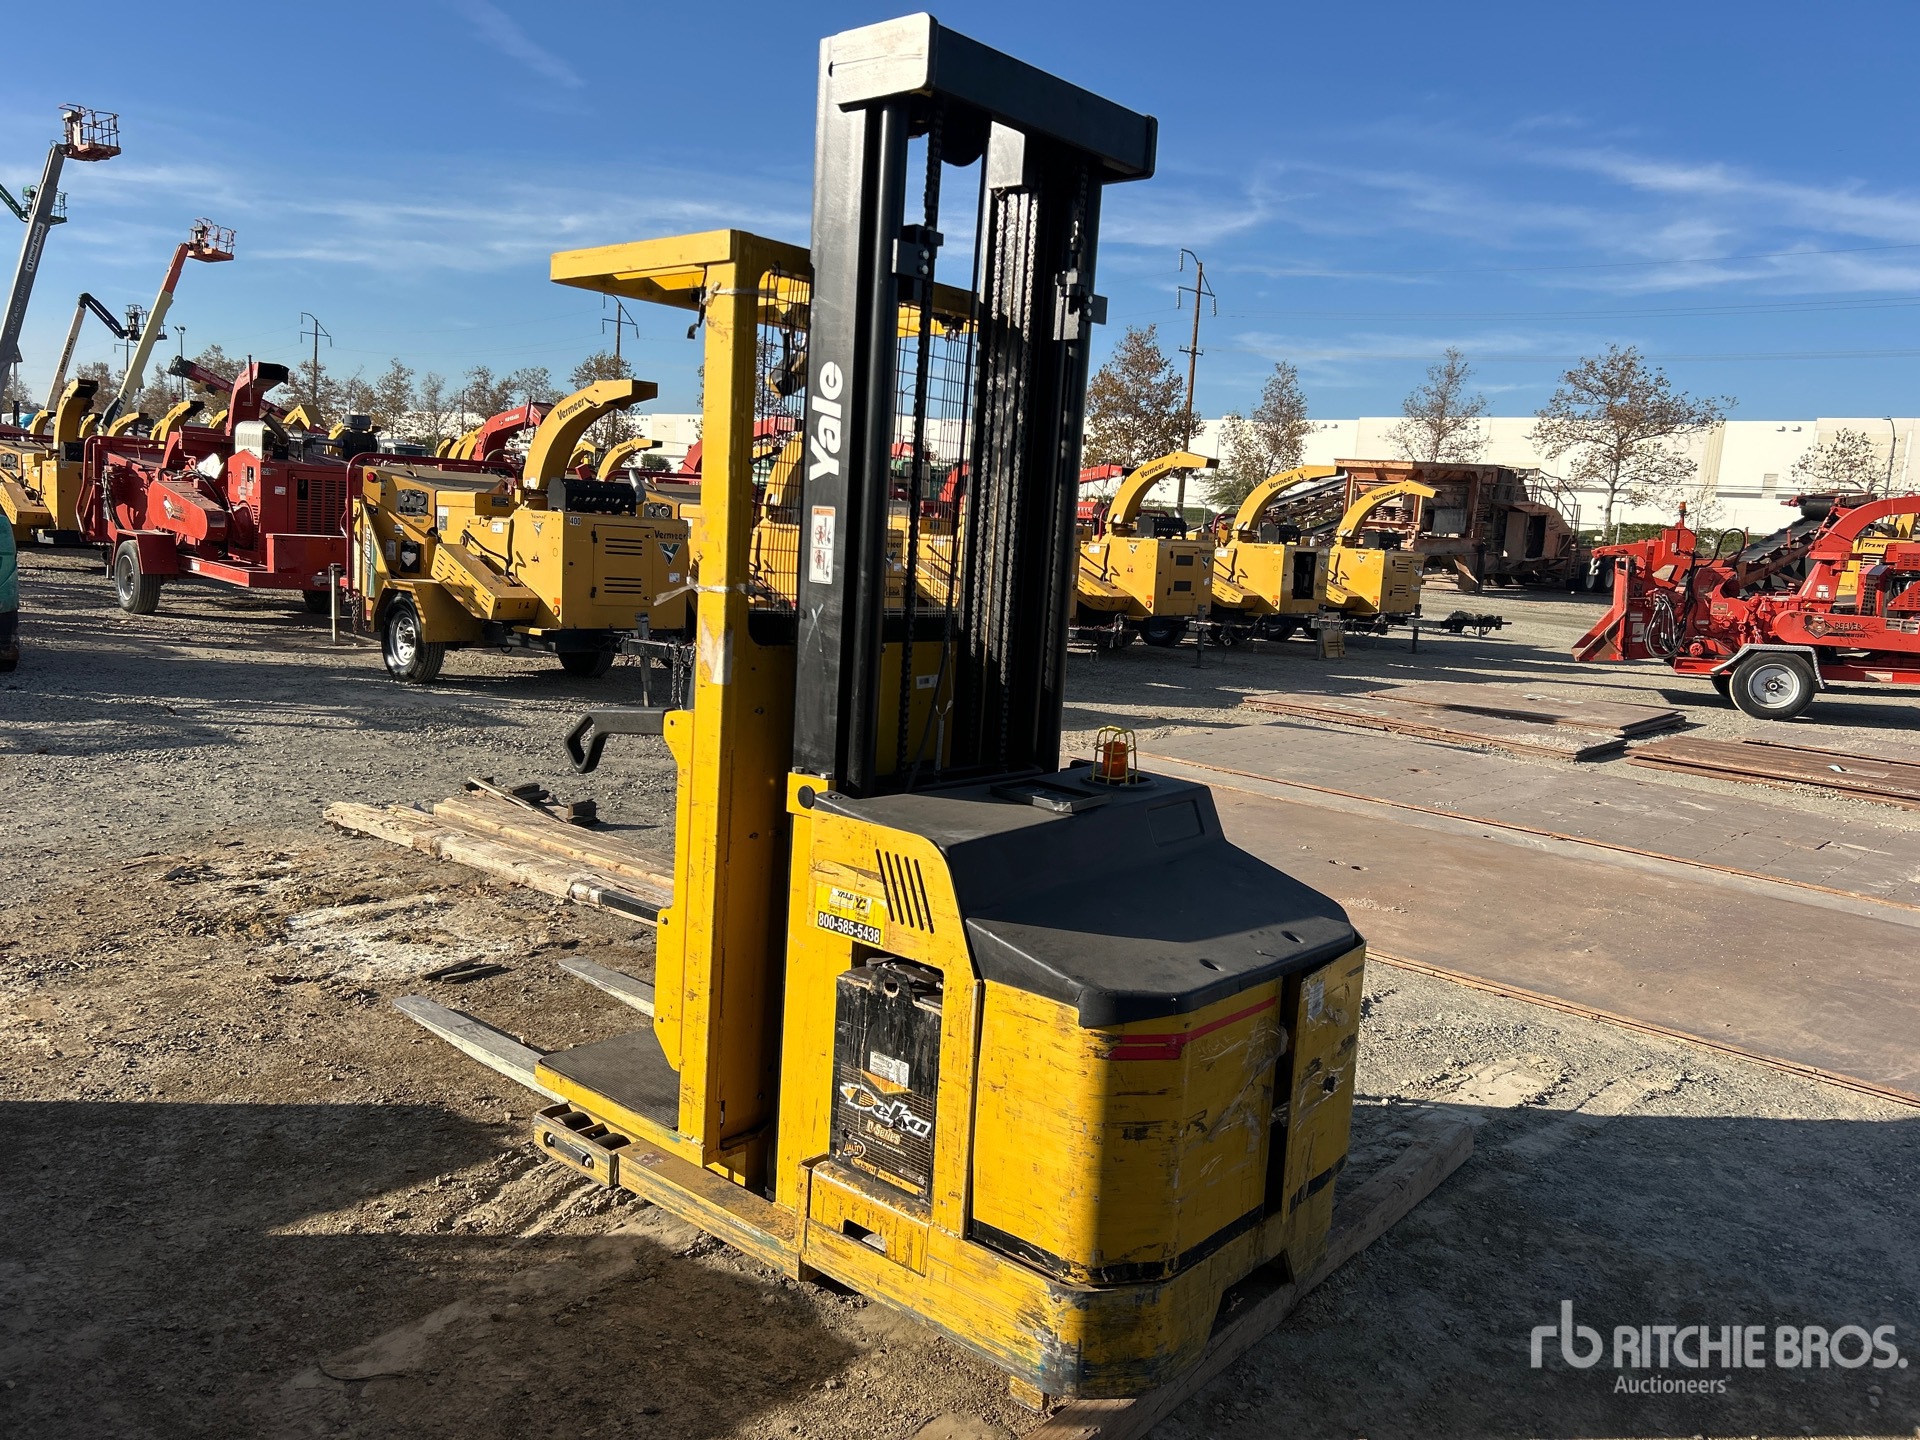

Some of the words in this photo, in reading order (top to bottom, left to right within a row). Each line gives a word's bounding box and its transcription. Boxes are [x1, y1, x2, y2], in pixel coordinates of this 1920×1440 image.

[29, 244, 39, 263] United
[35, 224, 44, 246] Rentals
[556, 397, 586, 421] Vermeer
[809, 361, 844, 481] Yale
[616, 442, 634, 454] Vermeer
[1139, 462, 1166, 479] Vermeer
[1268, 475, 1295, 490] Vermeer
[1371, 488, 1397, 501] Vermeer
[654, 530, 688, 541] Vermeer
[818, 912, 881, 944] 800-585-5438
[840, 1081, 932, 1138] Deka
[844, 1141, 864, 1154] UALITY
